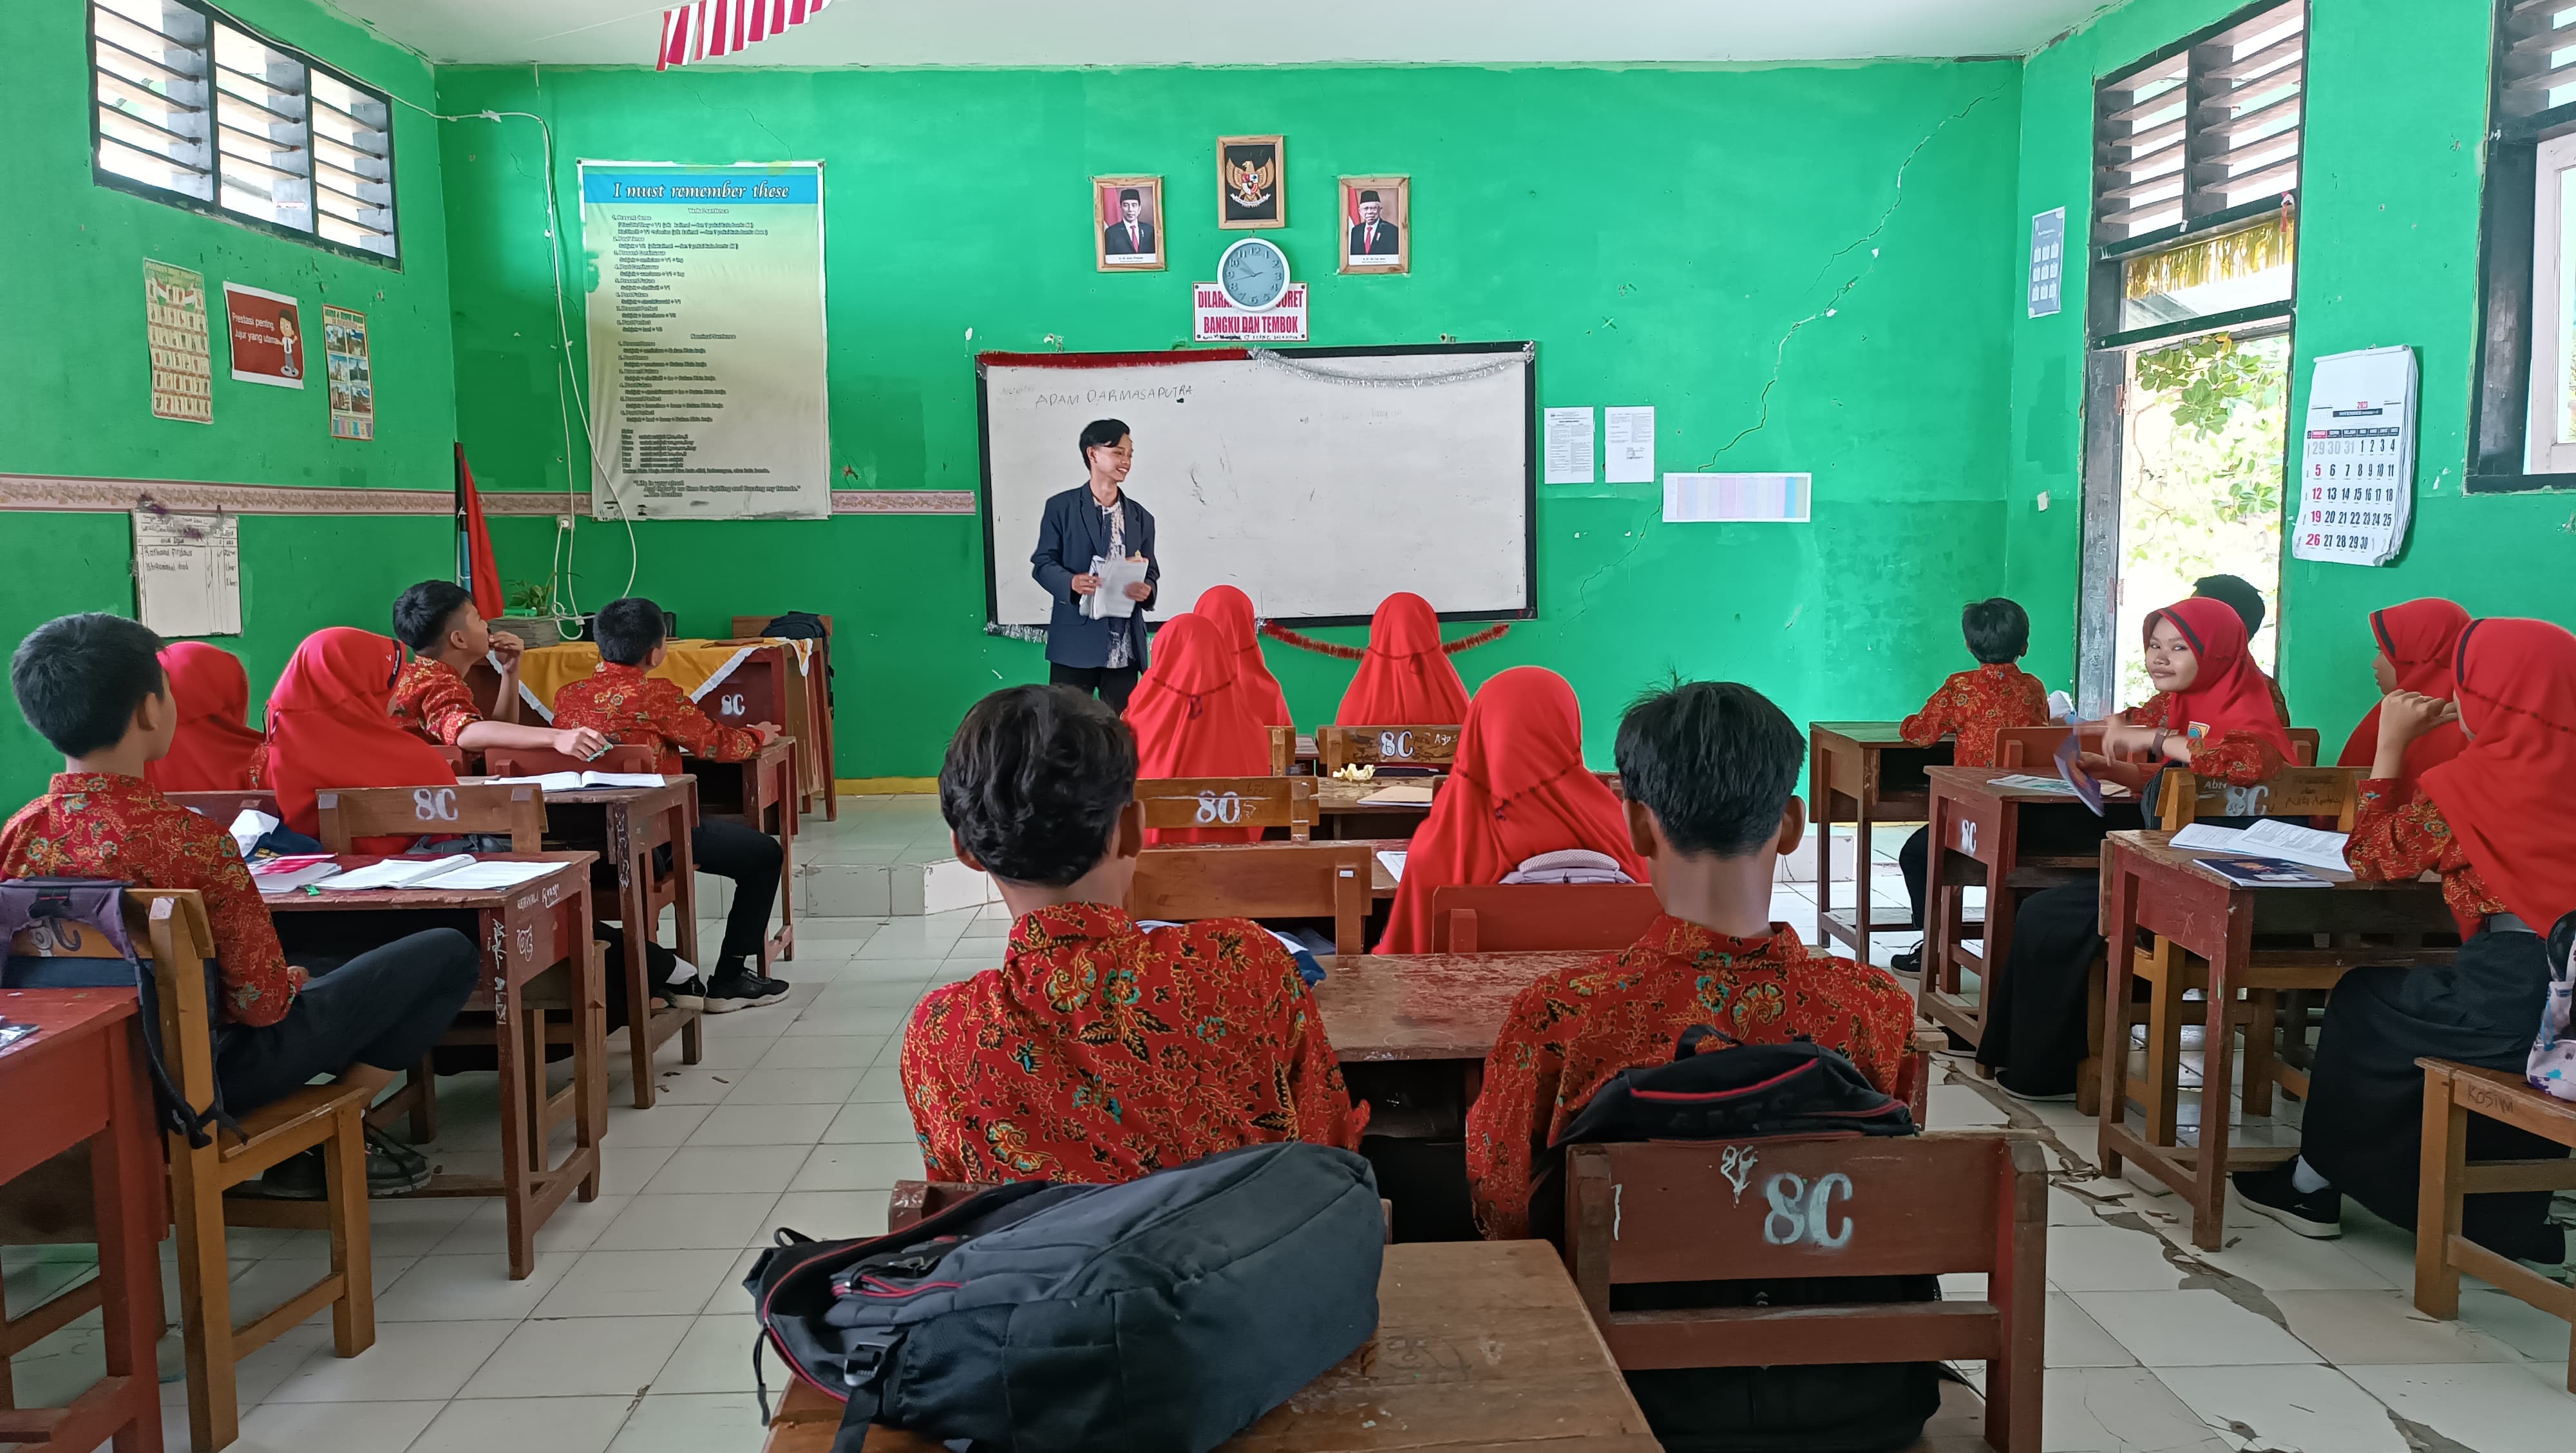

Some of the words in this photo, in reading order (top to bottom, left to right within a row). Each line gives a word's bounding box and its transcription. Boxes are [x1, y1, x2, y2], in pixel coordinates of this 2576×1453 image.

[613, 182, 622, 198] I
[625, 184, 665, 198] must
[670, 180, 747, 198] remember
[752, 180, 790, 198] these
[1237, 250, 1246, 258] 11
[1249, 247, 1261, 256] 12
[1229, 259, 1239, 267] 10
[1273, 260, 1279, 268] 2
[1229, 283, 1238, 291] 8
[1198, 290, 1233, 308] DILARA
[1276, 290, 1303, 308] ORET
[1249, 296, 1258, 304] 6
[232, 312, 255, 325] Prestasi
[1204, 316, 1240, 334] BANGKU
[1242, 316, 1260, 334] DAN
[1262, 316, 1298, 334] TEMBOK
[247, 332, 263, 344] yang
[1036, 394, 1079, 408] ADAM
[2313, 441, 2325, 455] 29
[2328, 441, 2340, 455] 30
[2344, 440, 2354, 455] 31
[2361, 439, 2364, 453] 1
[2370, 439, 2374, 452] 2
[2380, 439, 2385, 452] 3
[2390, 439, 2395, 452] 4
[2315, 464, 2321, 477] 5
[2329, 464, 2336, 477] 6
[2345, 464, 2351, 477] 7
[2358, 463, 2363, 477] 8
[2368, 463, 2372, 477] 9
[2377, 463, 2384, 477] 10
[2388, 463, 2394, 477] 11
[2312, 488, 2322, 500] 12
[2327, 488, 2337, 500] 13
[2342, 488, 2350, 500] 14
[2354, 488, 2362, 501] 15
[2365, 488, 2372, 501] 16
[2375, 488, 2382, 502] 17
[2385, 488, 2393, 502] 18
[2311, 510, 2322, 523] 19
[2325, 511, 2335, 524] 20
[2338, 511, 2347, 524] 21
[2350, 512, 2360, 525] 22
[2363, 512, 2371, 525] 23
[2372, 513, 2381, 526] 24
[2383, 513, 2392, 527] 25
[2306, 534, 2321, 546] 26
[2324, 535, 2333, 547] 27
[2336, 535, 2346, 548] 28
[2349, 536, 2359, 549] 29
[2360, 537, 2369, 550] 30
[721, 694, 746, 716] 8C
[1380, 729, 1414, 760] 8C
[414, 788, 459, 821] 8C
[2226, 785, 2269, 817] 8C
[1961, 819, 1977, 855] 8C
[1763, 1171, 1854, 1248] 8C
